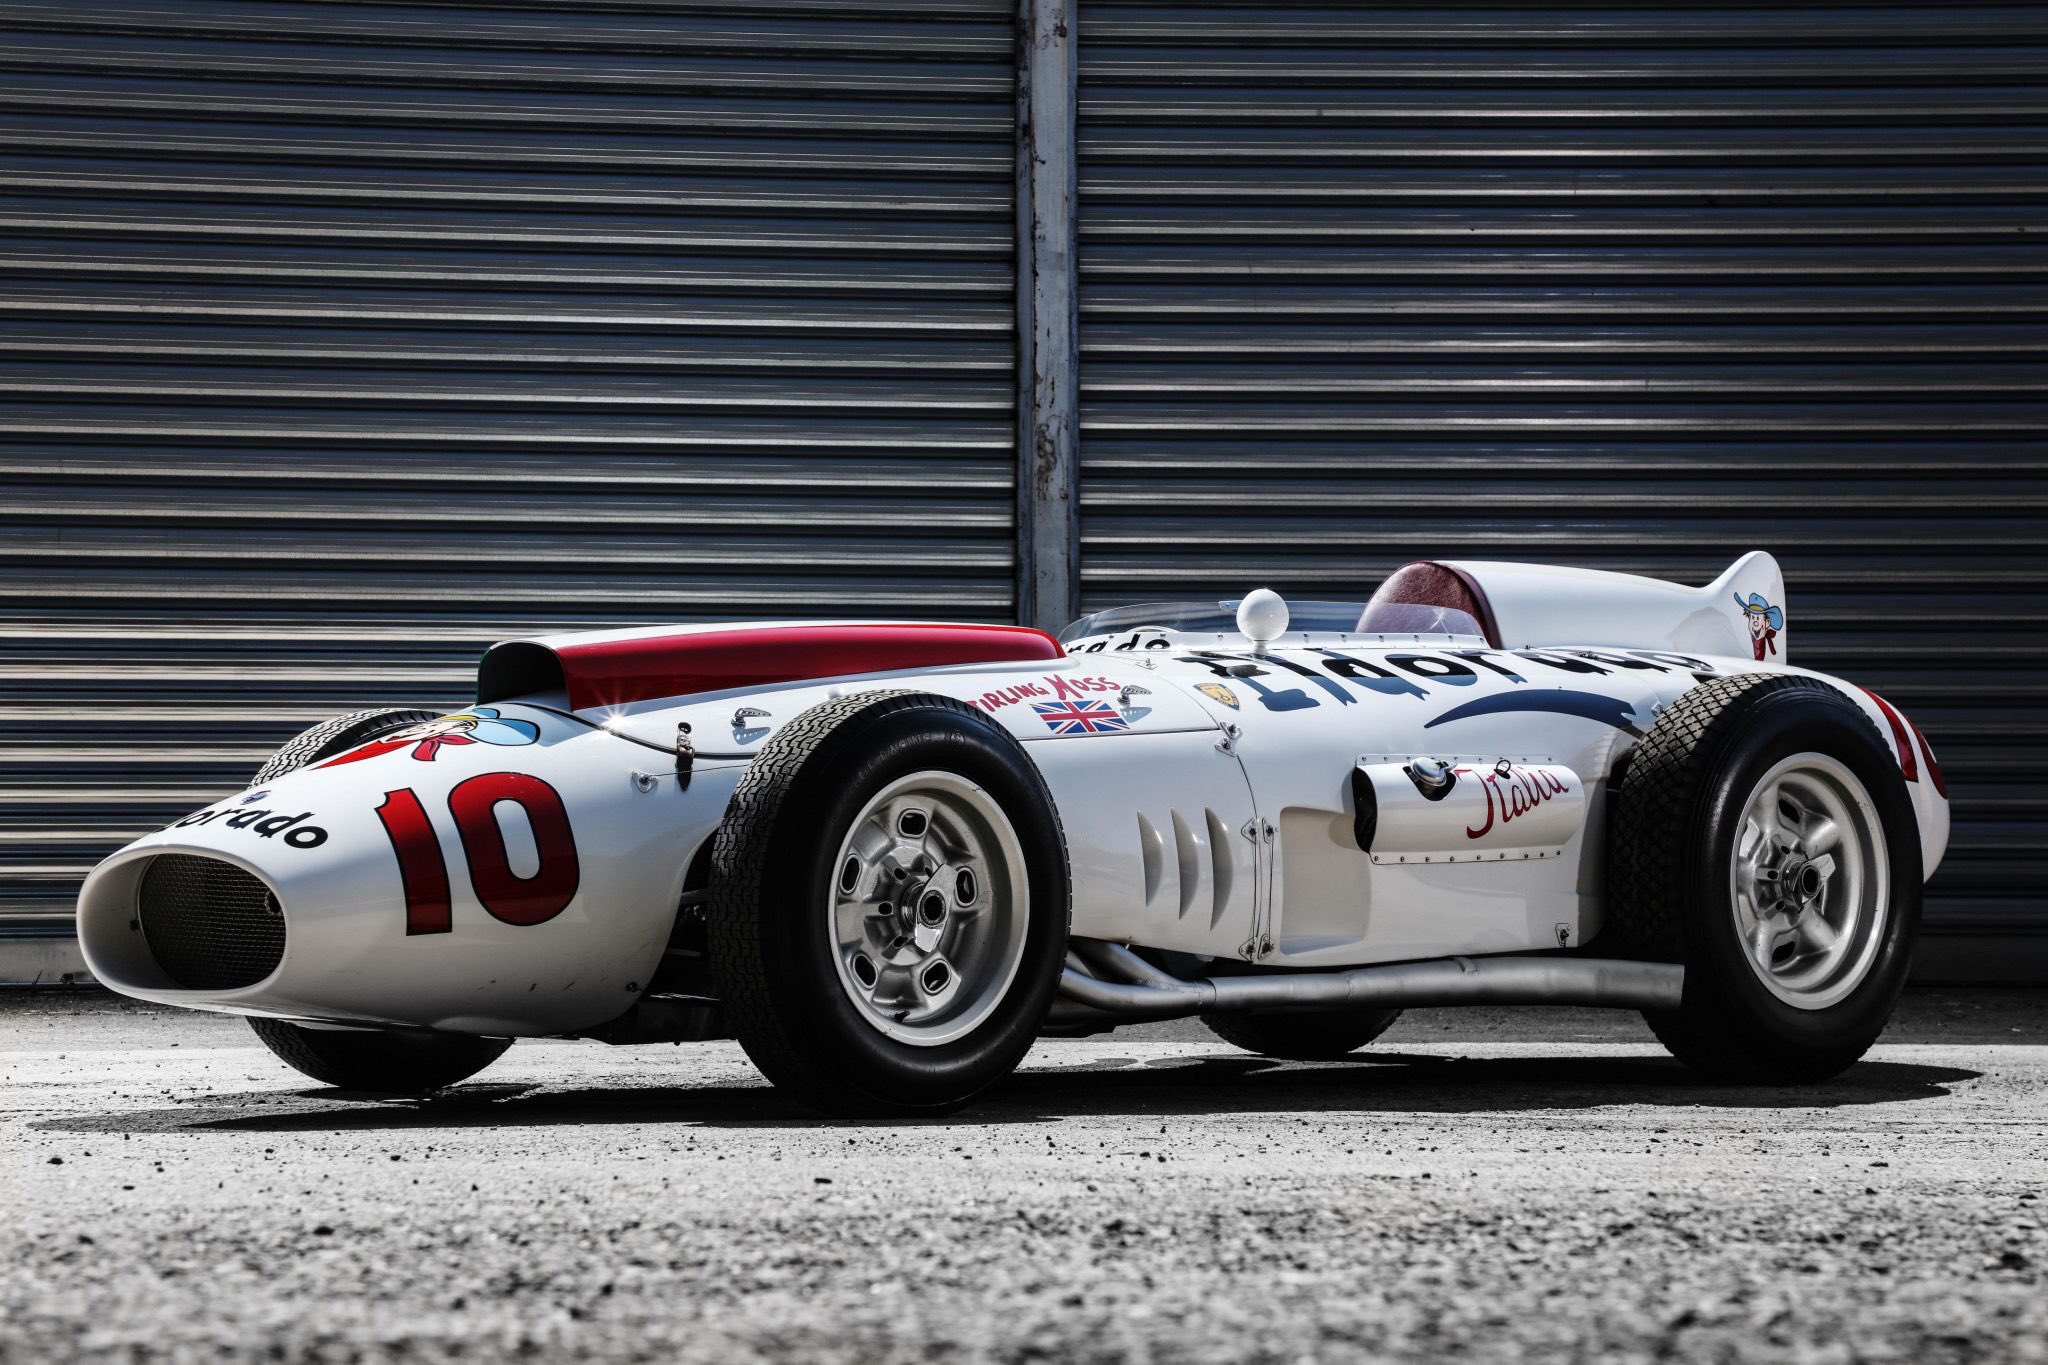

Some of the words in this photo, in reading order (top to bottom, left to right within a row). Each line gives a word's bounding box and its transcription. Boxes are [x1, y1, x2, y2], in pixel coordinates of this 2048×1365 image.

[153, 808, 329, 849] orado
[1453, 762, 1570, 840] Italia
[373, 771, 581, 937] 10
